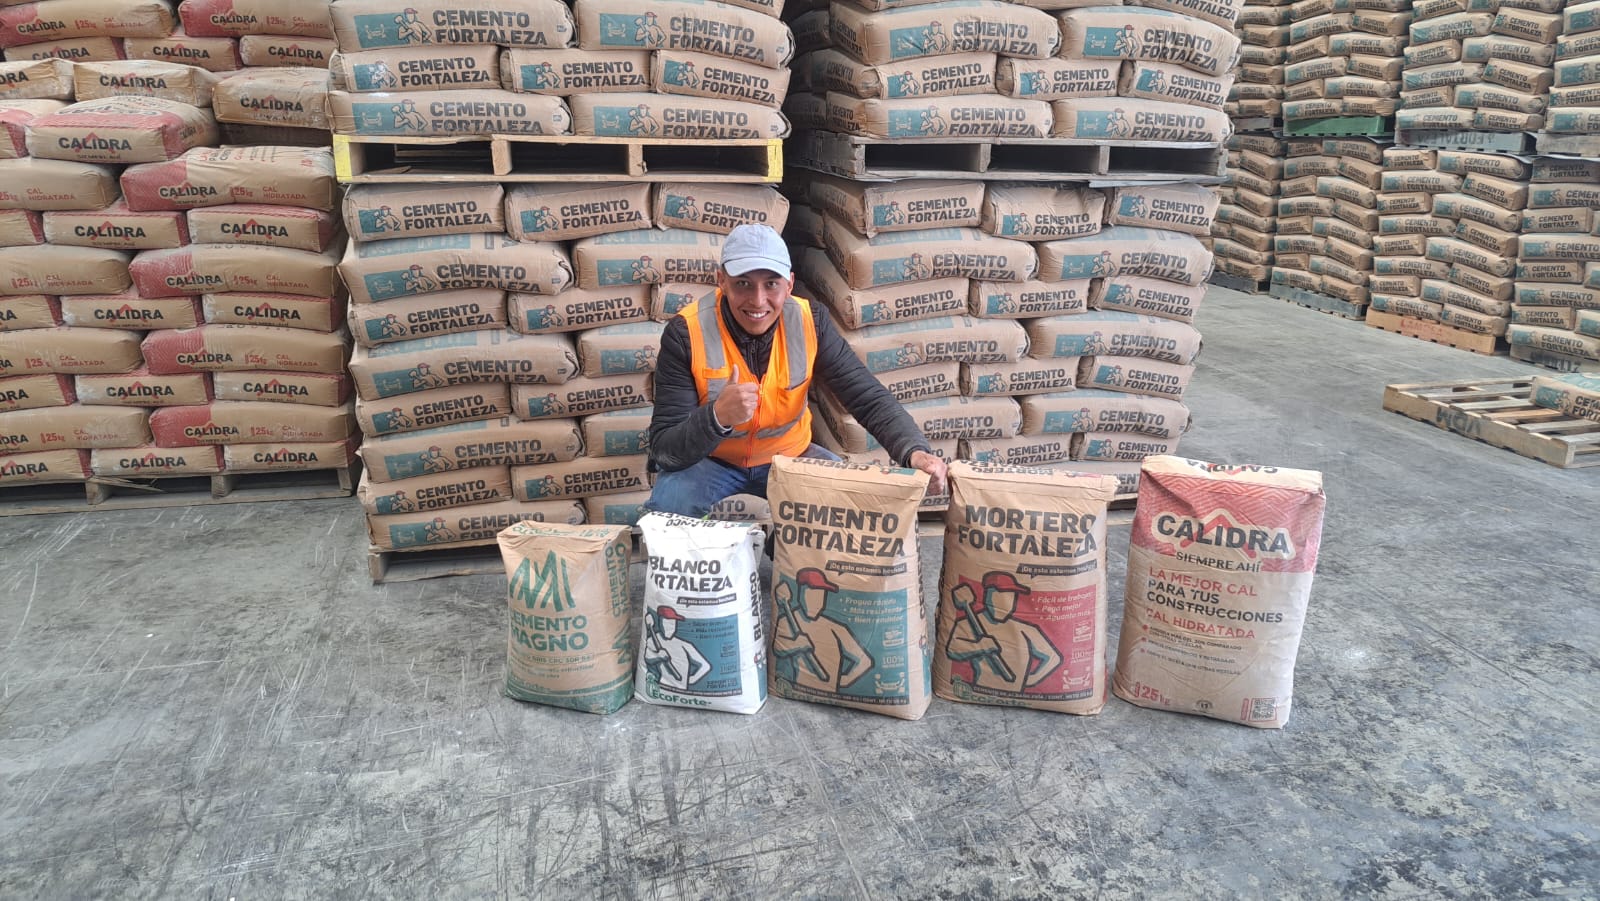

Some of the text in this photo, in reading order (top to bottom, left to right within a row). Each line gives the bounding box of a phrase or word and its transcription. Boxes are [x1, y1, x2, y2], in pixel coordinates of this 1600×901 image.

[212, 13, 257, 25] CALIDRA
[433, 10, 529, 27] CEMENTO
[1510, 17, 1539, 28] CEMENTO
[18, 20, 66, 34] CALIDRA
[953, 22, 1028, 39] CEMENTO
[436, 29, 547, 45] FORTALEZA
[153, 46, 210, 59] CALIDRA
[268, 46, 324, 59] CALIDRA
[670, 35, 764, 62] FORTALEZA
[952, 39, 1038, 56] FORTALEZA
[399, 57, 475, 73] CEMENTO
[562, 62, 633, 75] CEMENTO
[100, 75, 167, 89] CALIDRA
[564, 75, 645, 88] FORTALEZA
[704, 67, 769, 89] CEMENTO
[1054, 69, 1108, 81] CEMENTO
[1500, 69, 1527, 81] CEMENTO
[923, 73, 990, 93] FORTALEZA
[1053, 81, 1116, 93] FORTALEZA
[702, 81, 776, 103] FORTALEZA
[1167, 87, 1224, 105] FORTALEZA
[1483, 92, 1518, 105] CEMENTO
[240, 97, 303, 112] CALIDRA
[663, 108, 748, 125] CEMENTO
[951, 107, 1025, 121] CEMENTO
[432, 119, 543, 133] FORTALEZA
[950, 123, 1035, 136] FORTALEZA
[1131, 127, 1212, 142] FORTALEZA
[58, 137, 131, 151] CALIDRA
[1464, 158, 1500, 166] CEMENTO
[160, 185, 217, 198] CALIDRA
[403, 201, 477, 217] CEMENTO
[561, 200, 629, 216] CEMENTO
[908, 197, 967, 212] CEMENTO
[404, 213, 492, 230] FORTALEZA
[562, 211, 642, 229] FORTALEZA
[908, 208, 976, 224] FORTALEZA
[1035, 213, 1089, 225] CEMENTO
[1539, 215, 1573, 223] CEMENTO
[75, 225, 145, 238] CALIDRA
[221, 223, 288, 237] CALIDRA
[933, 254, 1007, 268] CEMENTO
[1122, 253, 1187, 269] CEMENTO
[167, 275, 221, 287] CALIDRA
[1118, 265, 1191, 284] FORTALEZA
[1020, 290, 1076, 303] CEMENTO
[1138, 289, 1190, 306] CEMENTO
[1550, 291, 1593, 300] CEMENTO
[234, 306, 300, 320] CALIDRA
[566, 297, 632, 314] CEMENTO
[1019, 300, 1083, 313] FORTALEZA
[1134, 300, 1193, 317] FORTALEZA
[94, 308, 163, 321] CALIDRA
[567, 307, 644, 325] FORTALEZA
[410, 314, 494, 334] FORTALEZA
[926, 341, 998, 355] CEMENTO
[1542, 334, 1583, 347] CEMENTO
[178, 352, 233, 364] CALIDRA
[444, 360, 532, 375] CEMENTO
[888, 373, 945, 393] CEMENTO
[1010, 369, 1065, 382] CEMENTO
[106, 385, 174, 397] CALIDRA
[243, 382, 309, 396] CALIDRA
[1009, 378, 1072, 391] FORTALEZA
[567, 385, 633, 403] CEMENTO
[413, 395, 483, 416] CEMENTO
[416, 405, 497, 426] FORTALEZA
[1100, 410, 1165, 425] CEMENTO
[185, 425, 239, 437] CALIDRA
[1095, 423, 1169, 438] FORTALEZA
[455, 440, 541, 458] CEMENTO
[1007, 443, 1060, 456] CEMENTO
[120, 456, 186, 468] CALIDRA
[254, 452, 318, 463] CALIDRA
[1007, 452, 1068, 465] FORTALEZA
[564, 468, 629, 484] CEMENTO
[416, 480, 485, 499] CEMENTO
[565, 477, 641, 494] FORTALEZA
[418, 489, 499, 510] FORTALEZA
[779, 501, 899, 533] CEMENTO
[966, 505, 1096, 534] MORTERO
[774, 522, 905, 557] FORTALEZA
[958, 525, 1096, 558] FORTALEZA
[1158, 515, 1289, 553] CALIDRA
[650, 556, 721, 574] BLANCO
[1176, 551, 1260, 573] SIEMPRE AHÍ
[652, 574, 733, 592] RTALEZA
[1150, 568, 1257, 596] LA MEJOR CAL
[1148, 580, 1220, 604] PARA TUS
[750, 571, 762, 642] BLANCO
[1147, 592, 1283, 622] CONSTRUCCIONES
[511, 612, 587, 631] EMENTO
[1146, 608, 1169, 624] CAL
[1173, 616, 1256, 639] HIDRATADA
